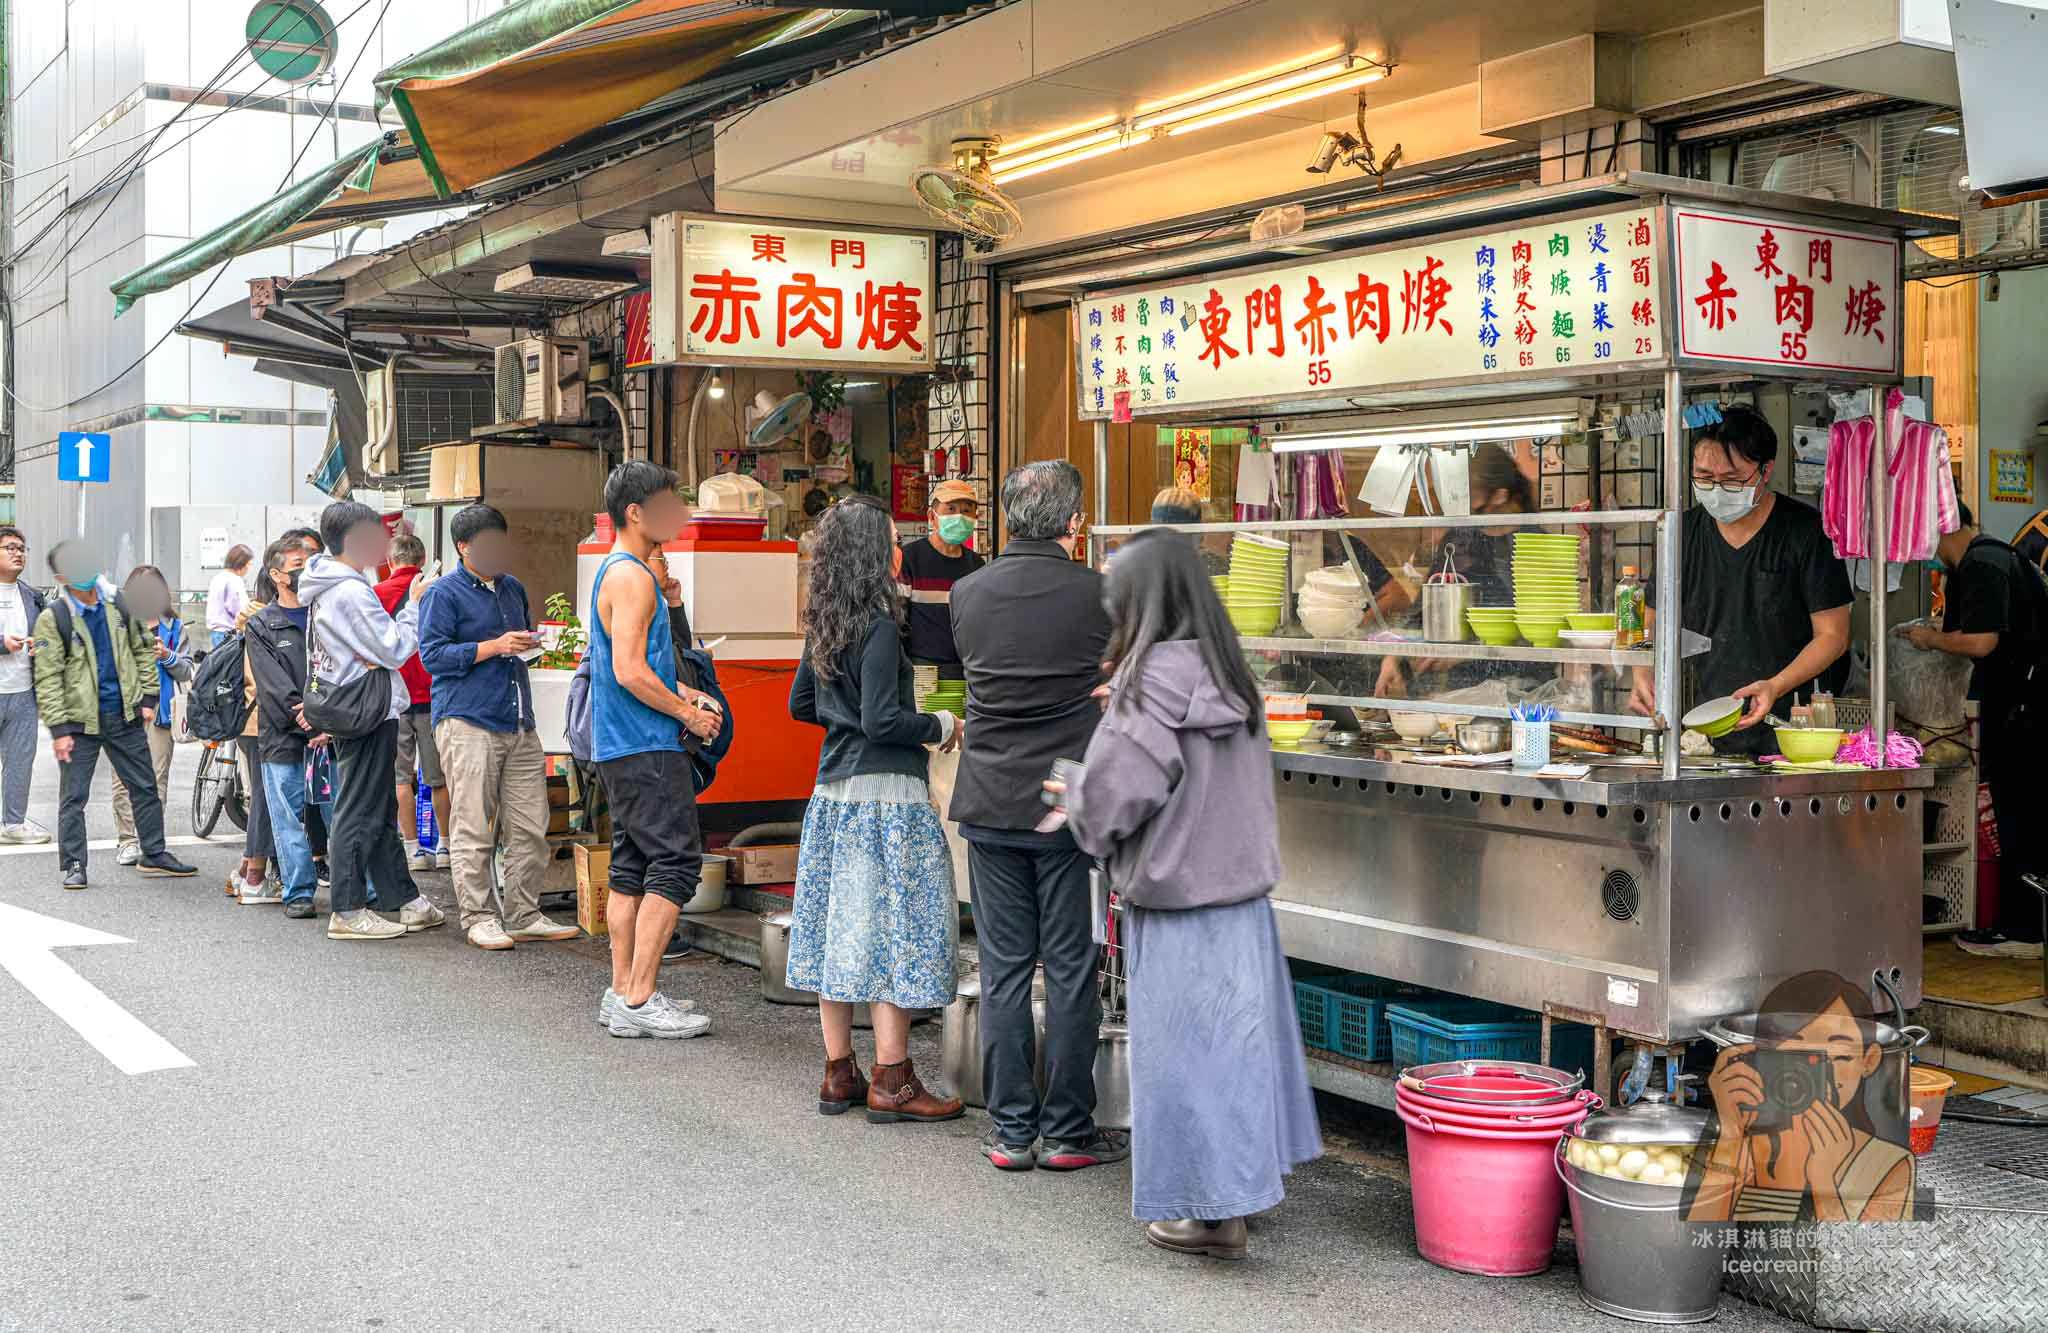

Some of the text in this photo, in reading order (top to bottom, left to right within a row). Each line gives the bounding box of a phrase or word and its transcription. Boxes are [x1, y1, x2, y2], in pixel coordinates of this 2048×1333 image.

[750, 234, 866, 269] 東門
[1754, 229, 1832, 284] 東門
[1111, 303, 1131, 386] 甜不辣
[1594, 342, 1611, 358] 30
[1635, 338, 1651, 354] 25
[1780, 332, 1808, 360] 55
[1483, 354, 1497, 370] 65
[1519, 351, 1534, 367] 65
[1556, 347, 1570, 362] 65
[1307, 360, 1332, 386] 55
[1141, 389, 1152, 402] 35
[1166, 387, 1176, 400] 65
